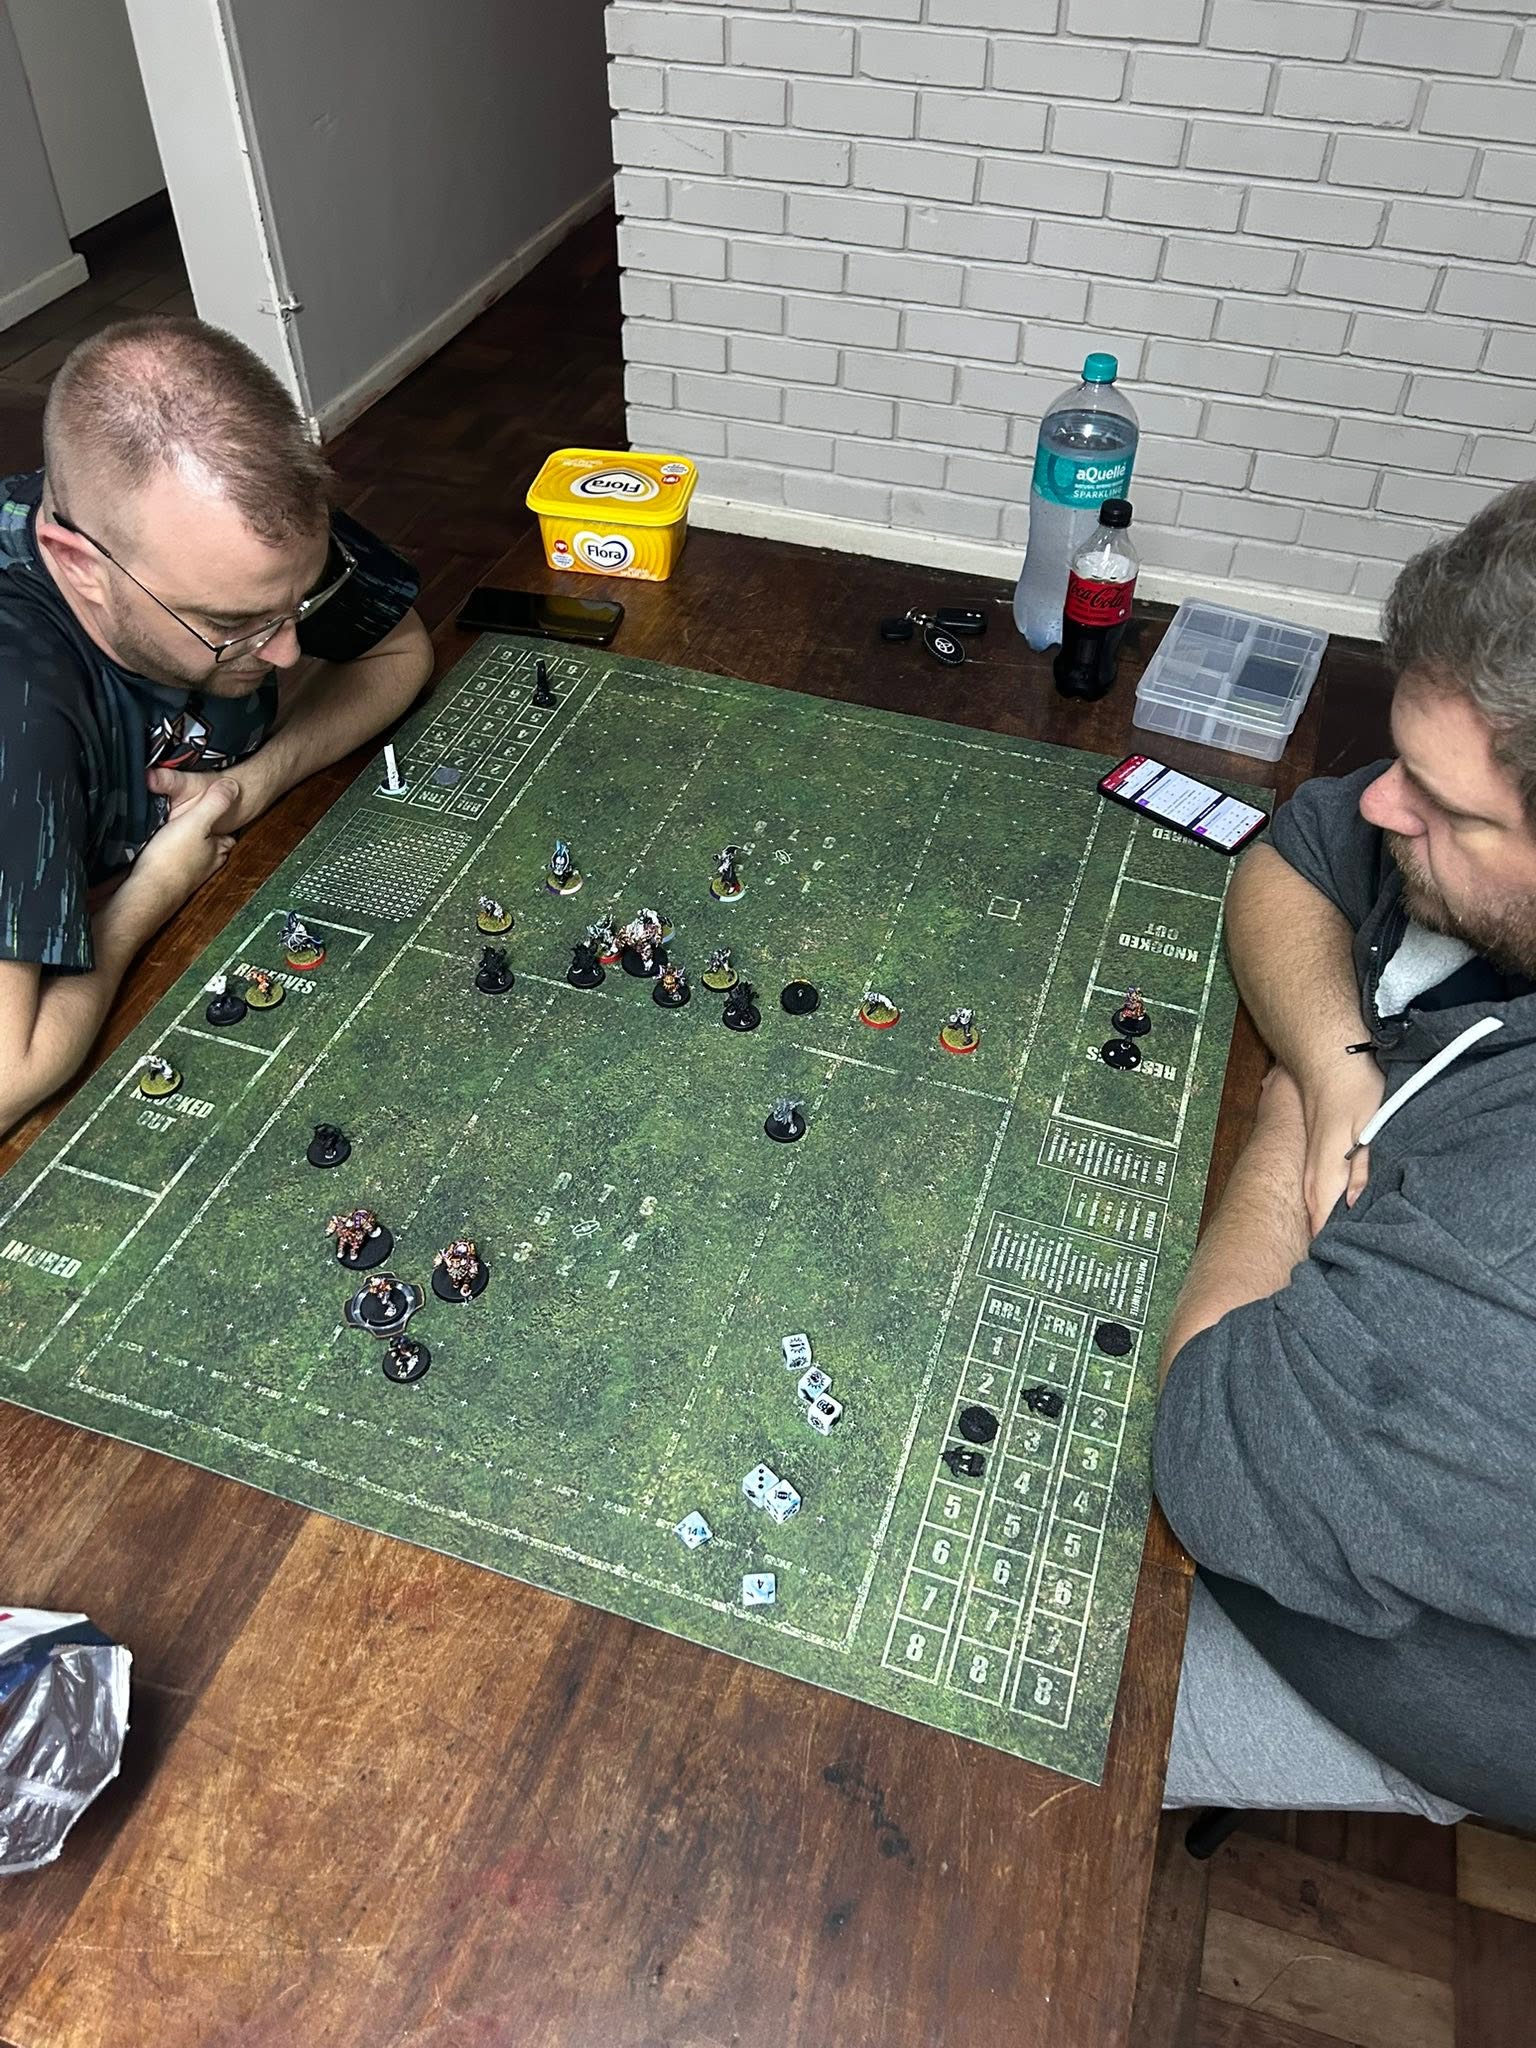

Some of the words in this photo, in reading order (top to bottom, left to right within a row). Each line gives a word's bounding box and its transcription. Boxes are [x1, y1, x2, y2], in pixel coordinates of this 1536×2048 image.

[1076, 465, 1126, 483] aQuelle
[591, 479, 641, 493] Flora
[1073, 486, 1123, 498] SPARKLING
[587, 545, 622, 560] Flora
[474, 682, 487, 691] 6
[530, 713, 543, 723] 5
[454, 755, 468, 766] 2
[504, 746, 516, 757] 3
[490, 763, 503, 775] 2
[418, 790, 445, 804] TRN
[1144, 923, 1179, 941] OUT
[1118, 933, 1199, 962] KNOCKED
[232, 962, 317, 995] REERVES
[136, 1110, 178, 1133] OUT
[534, 1205, 554, 1226] 5
[1142, 1209, 1157, 1239] WEATHER
[512, 1242, 533, 1262] 3
[622, 1231, 641, 1251] 4
[0, 1239, 83, 1279] INJURED
[1135, 1257, 1149, 1286] PRAYERS
[1133, 1284, 1143, 1294] TO
[988, 1298, 1022, 1322] RRL
[1043, 1315, 1079, 1339] TRN
[991, 1336, 1004, 1356] 1
[977, 1372, 995, 1395] 2
[1102, 1370, 1115, 1391] 1
[1090, 1407, 1108, 1431] 2
[1023, 1431, 1042, 1453] 3
[1081, 1447, 1099, 1472] 3
[1013, 1472, 1032, 1495] 4
[943, 1494, 962, 1520] 5
[1072, 1490, 1089, 1514] 4
[1003, 1513, 1022, 1539] 5
[931, 1539, 951, 1565] 6
[1063, 1532, 1082, 1558] 5
[992, 1558, 1012, 1585] 6
[921, 1585, 938, 1612] 7
[1054, 1579, 1073, 1606] 6
[984, 1606, 1000, 1633] 7
[905, 1633, 927, 1663] 8
[969, 1655, 989, 1684] 8
[1034, 1676, 1054, 1706] 8
